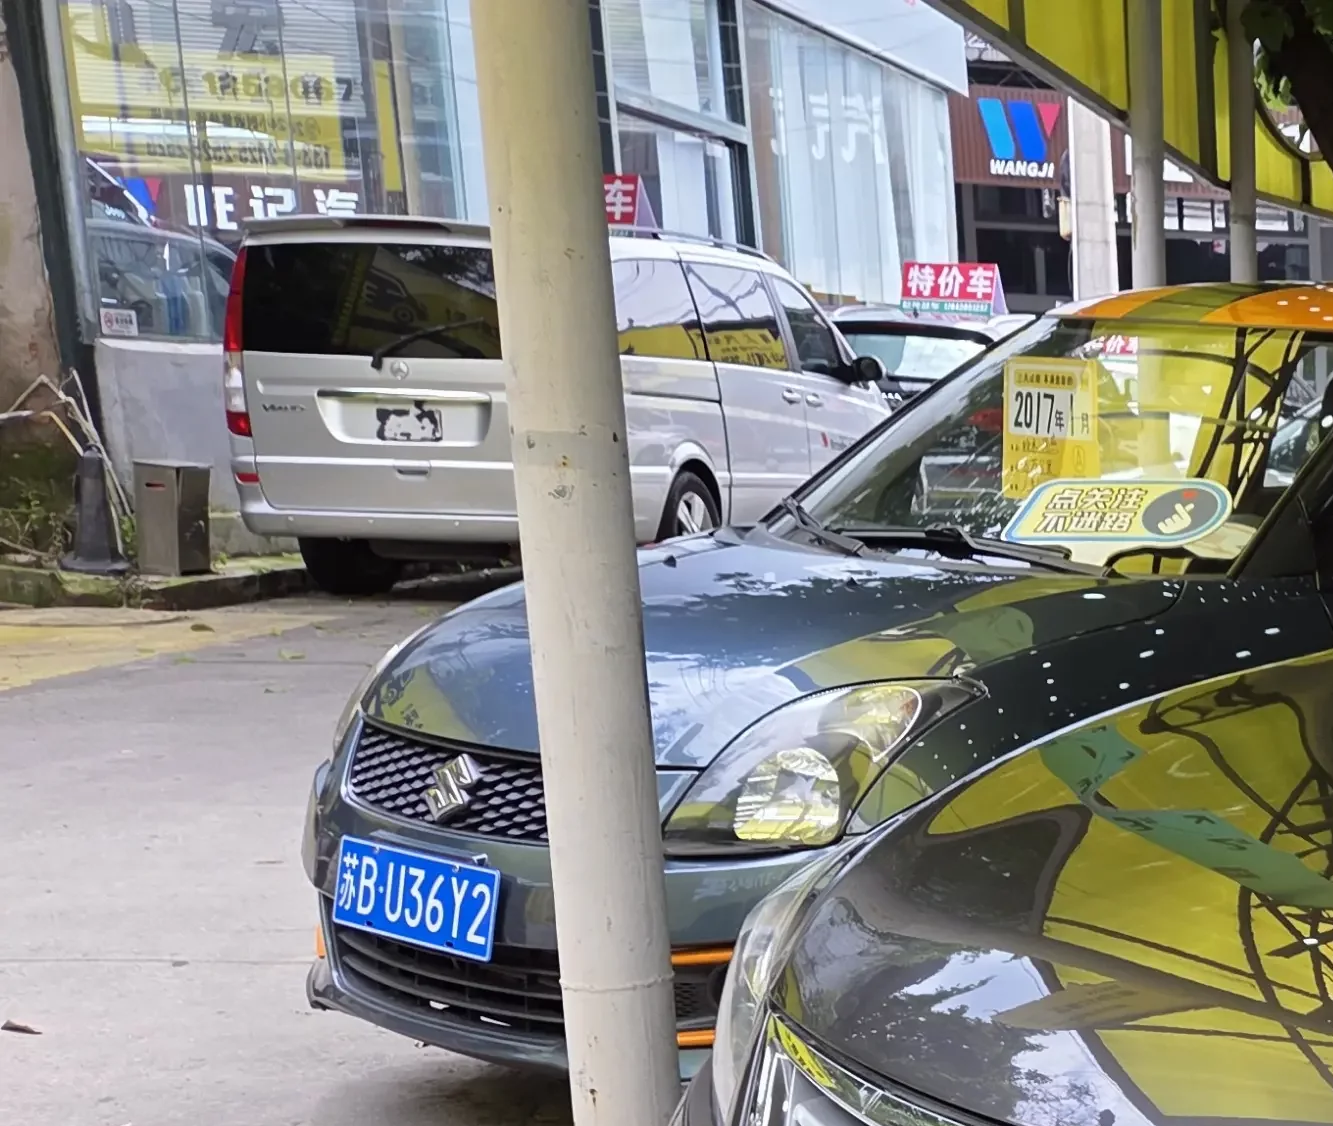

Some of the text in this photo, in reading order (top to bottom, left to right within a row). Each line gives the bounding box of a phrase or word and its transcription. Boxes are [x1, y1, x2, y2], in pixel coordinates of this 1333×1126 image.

[989, 158, 1055, 178] WANGJI
[906, 264, 994, 299] 特价车
[1045, 487, 1148, 510] 点关注
[1034, 511, 1136, 533] 不迷路
